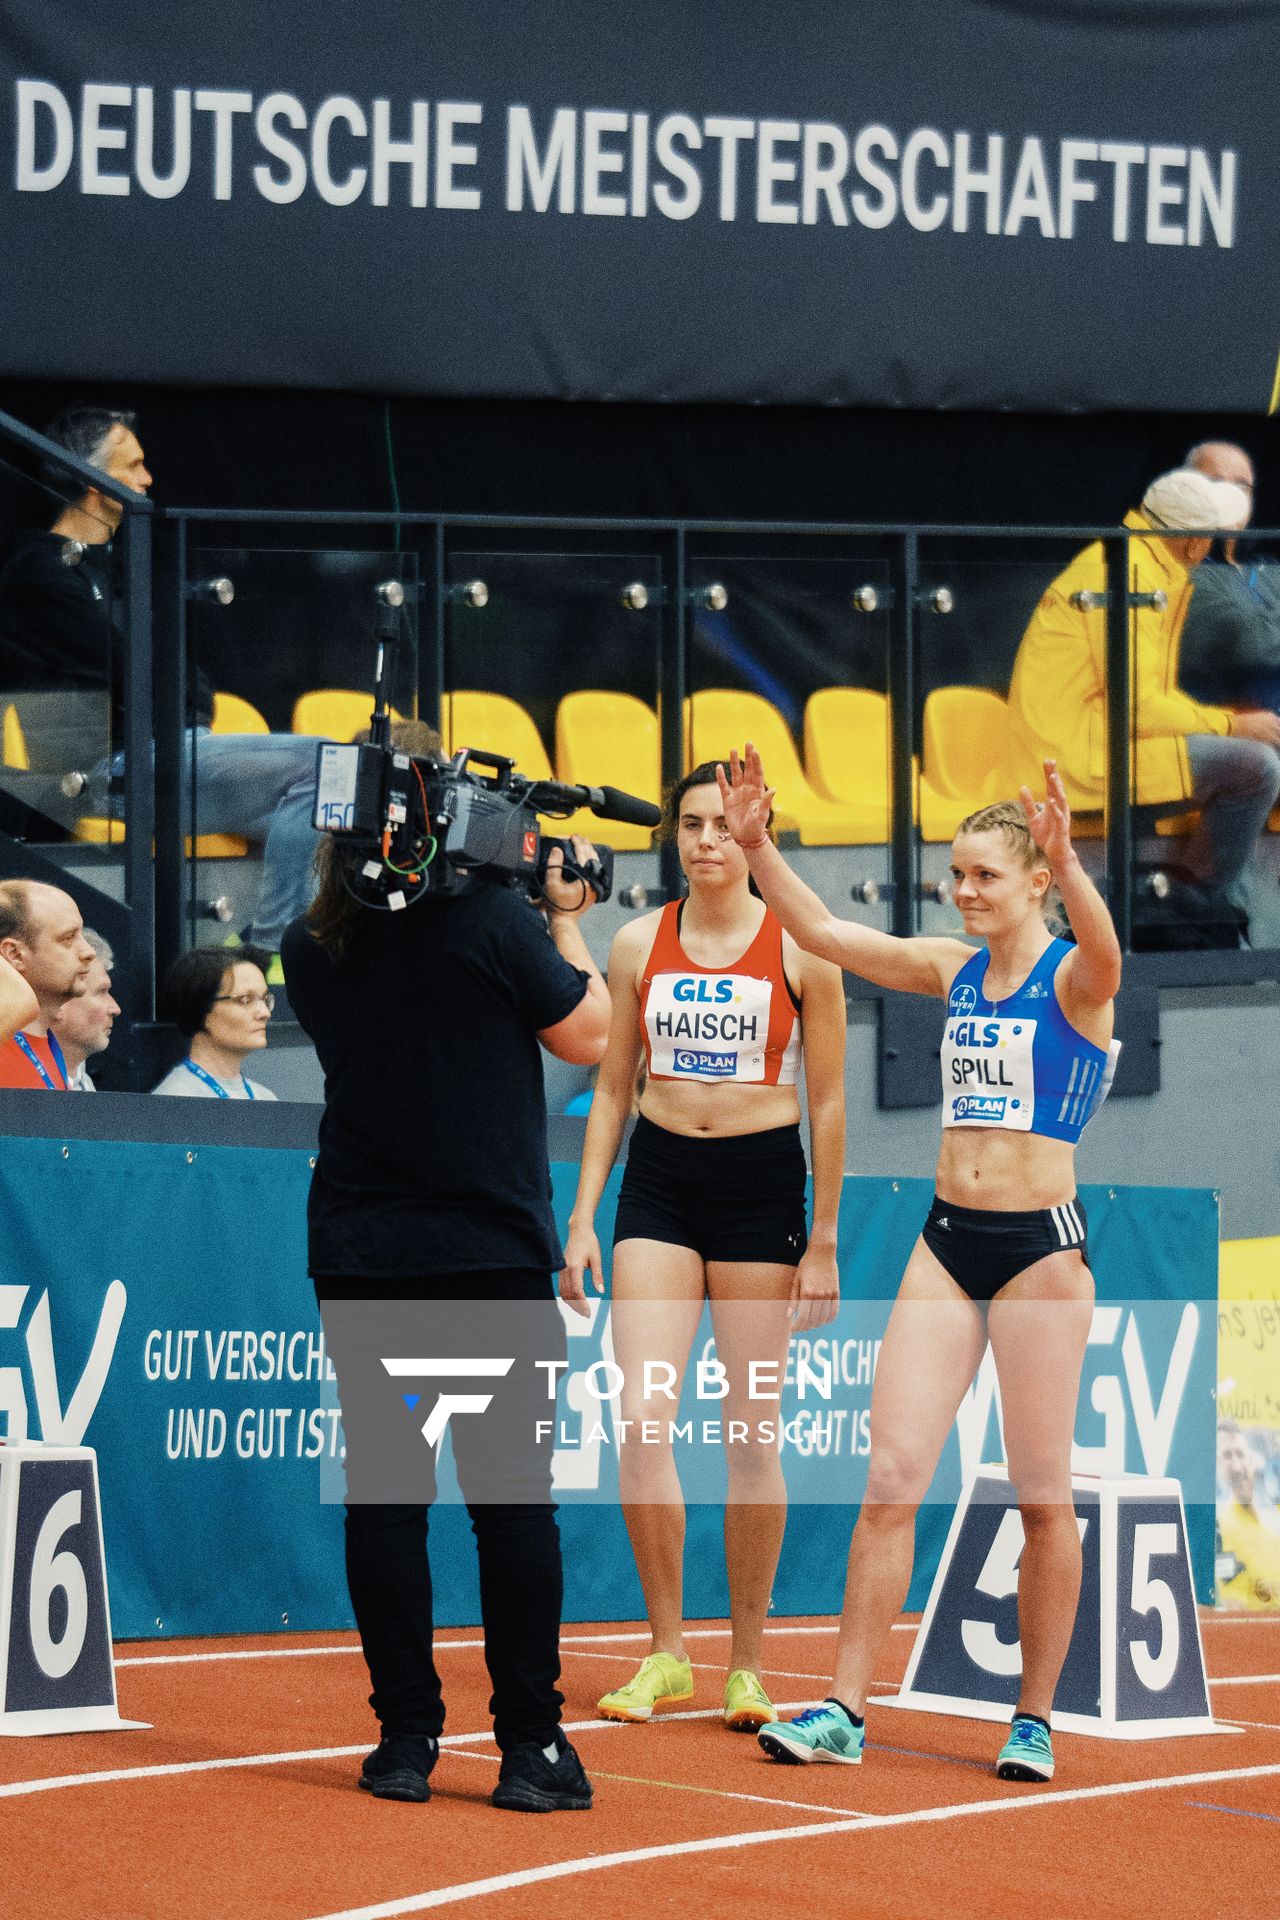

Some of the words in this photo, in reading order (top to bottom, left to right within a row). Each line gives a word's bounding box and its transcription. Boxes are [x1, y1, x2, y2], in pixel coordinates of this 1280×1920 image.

[15, 79, 483, 209] DEUTSCHE
[507, 104, 1237, 249] MEISTERSCHAFTEN
[656, 1012, 757, 1041] HAISCH
[700, 1055, 734, 1067] PLAN
[951, 1057, 1013, 1086] SPILL
[968, 1099, 1004, 1112] PLAN
[145, 1329, 199, 1380] GUT
[167, 1408, 227, 1460] UND
[236, 1408, 292, 1459] GUT
[29, 1489, 88, 1678] 6
[1129, 1523, 1179, 1691] 5
